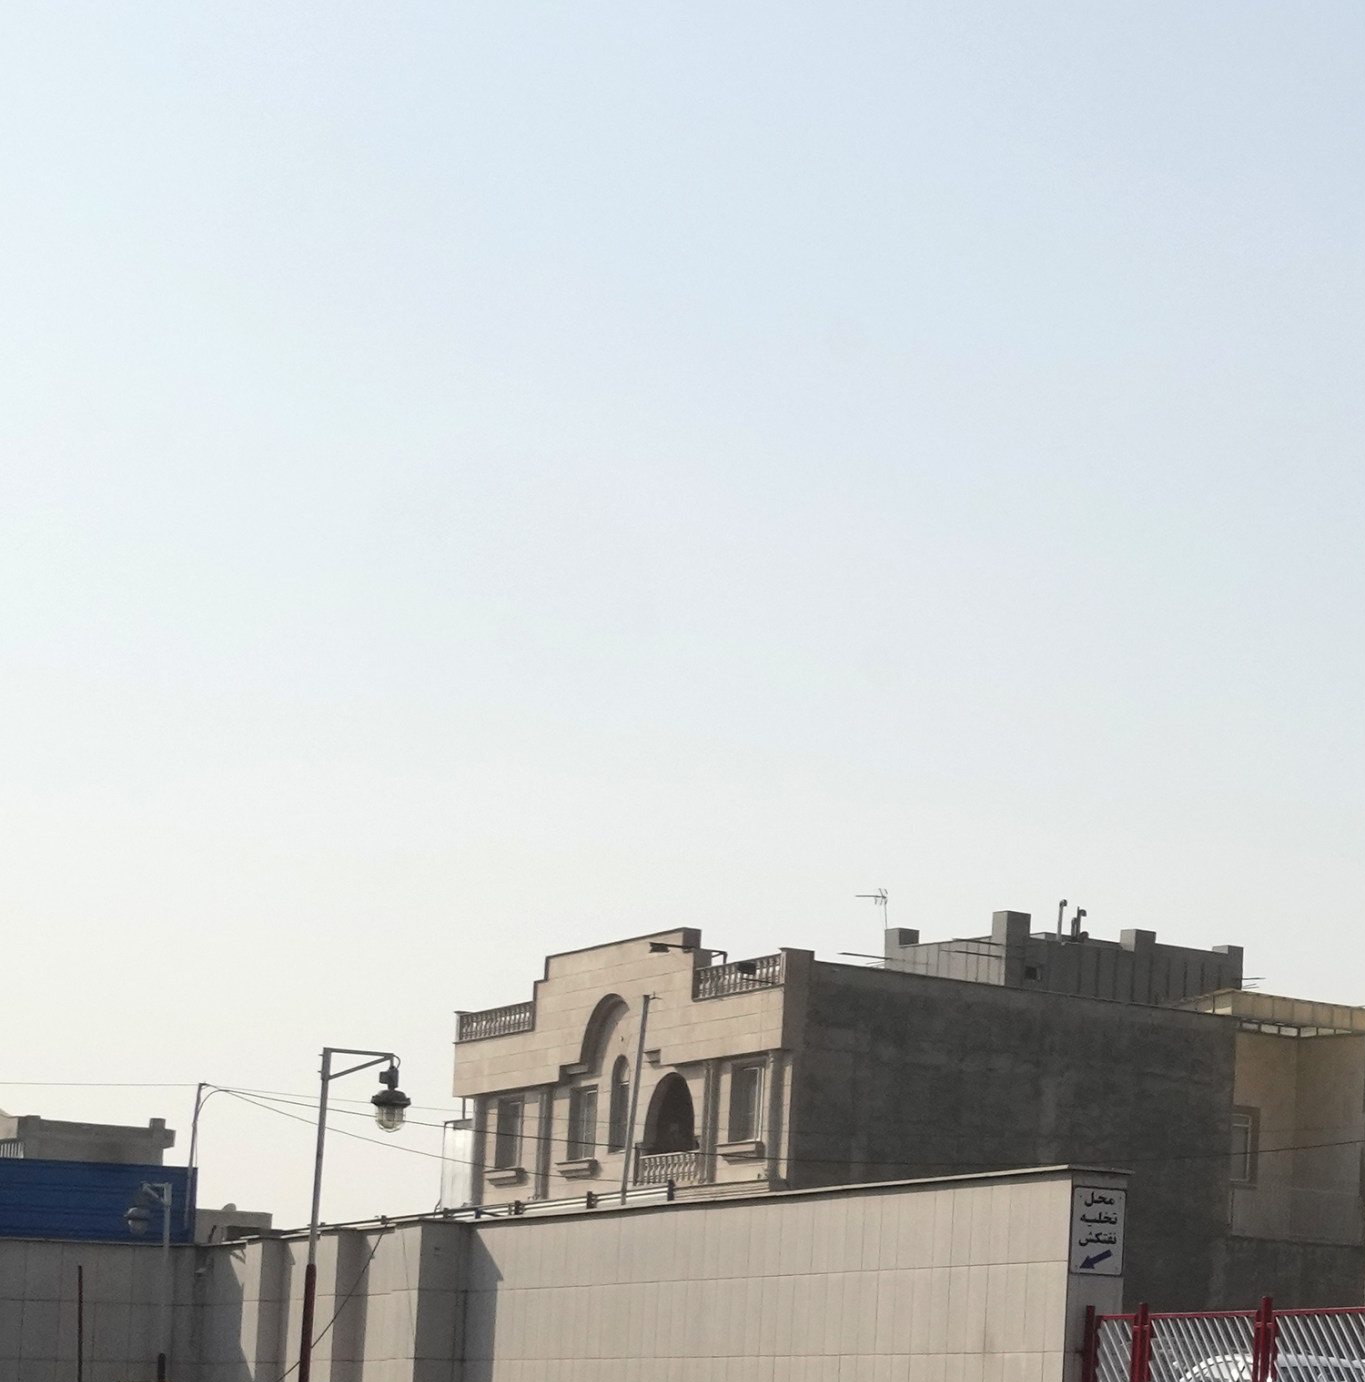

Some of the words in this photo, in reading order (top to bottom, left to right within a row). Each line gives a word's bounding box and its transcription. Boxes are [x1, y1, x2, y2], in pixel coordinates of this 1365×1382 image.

[1084, 1191, 1115, 1207] محل
[1080, 1211, 1118, 1227] تخلیه
[1079, 1231, 1117, 1247] نفتکش
